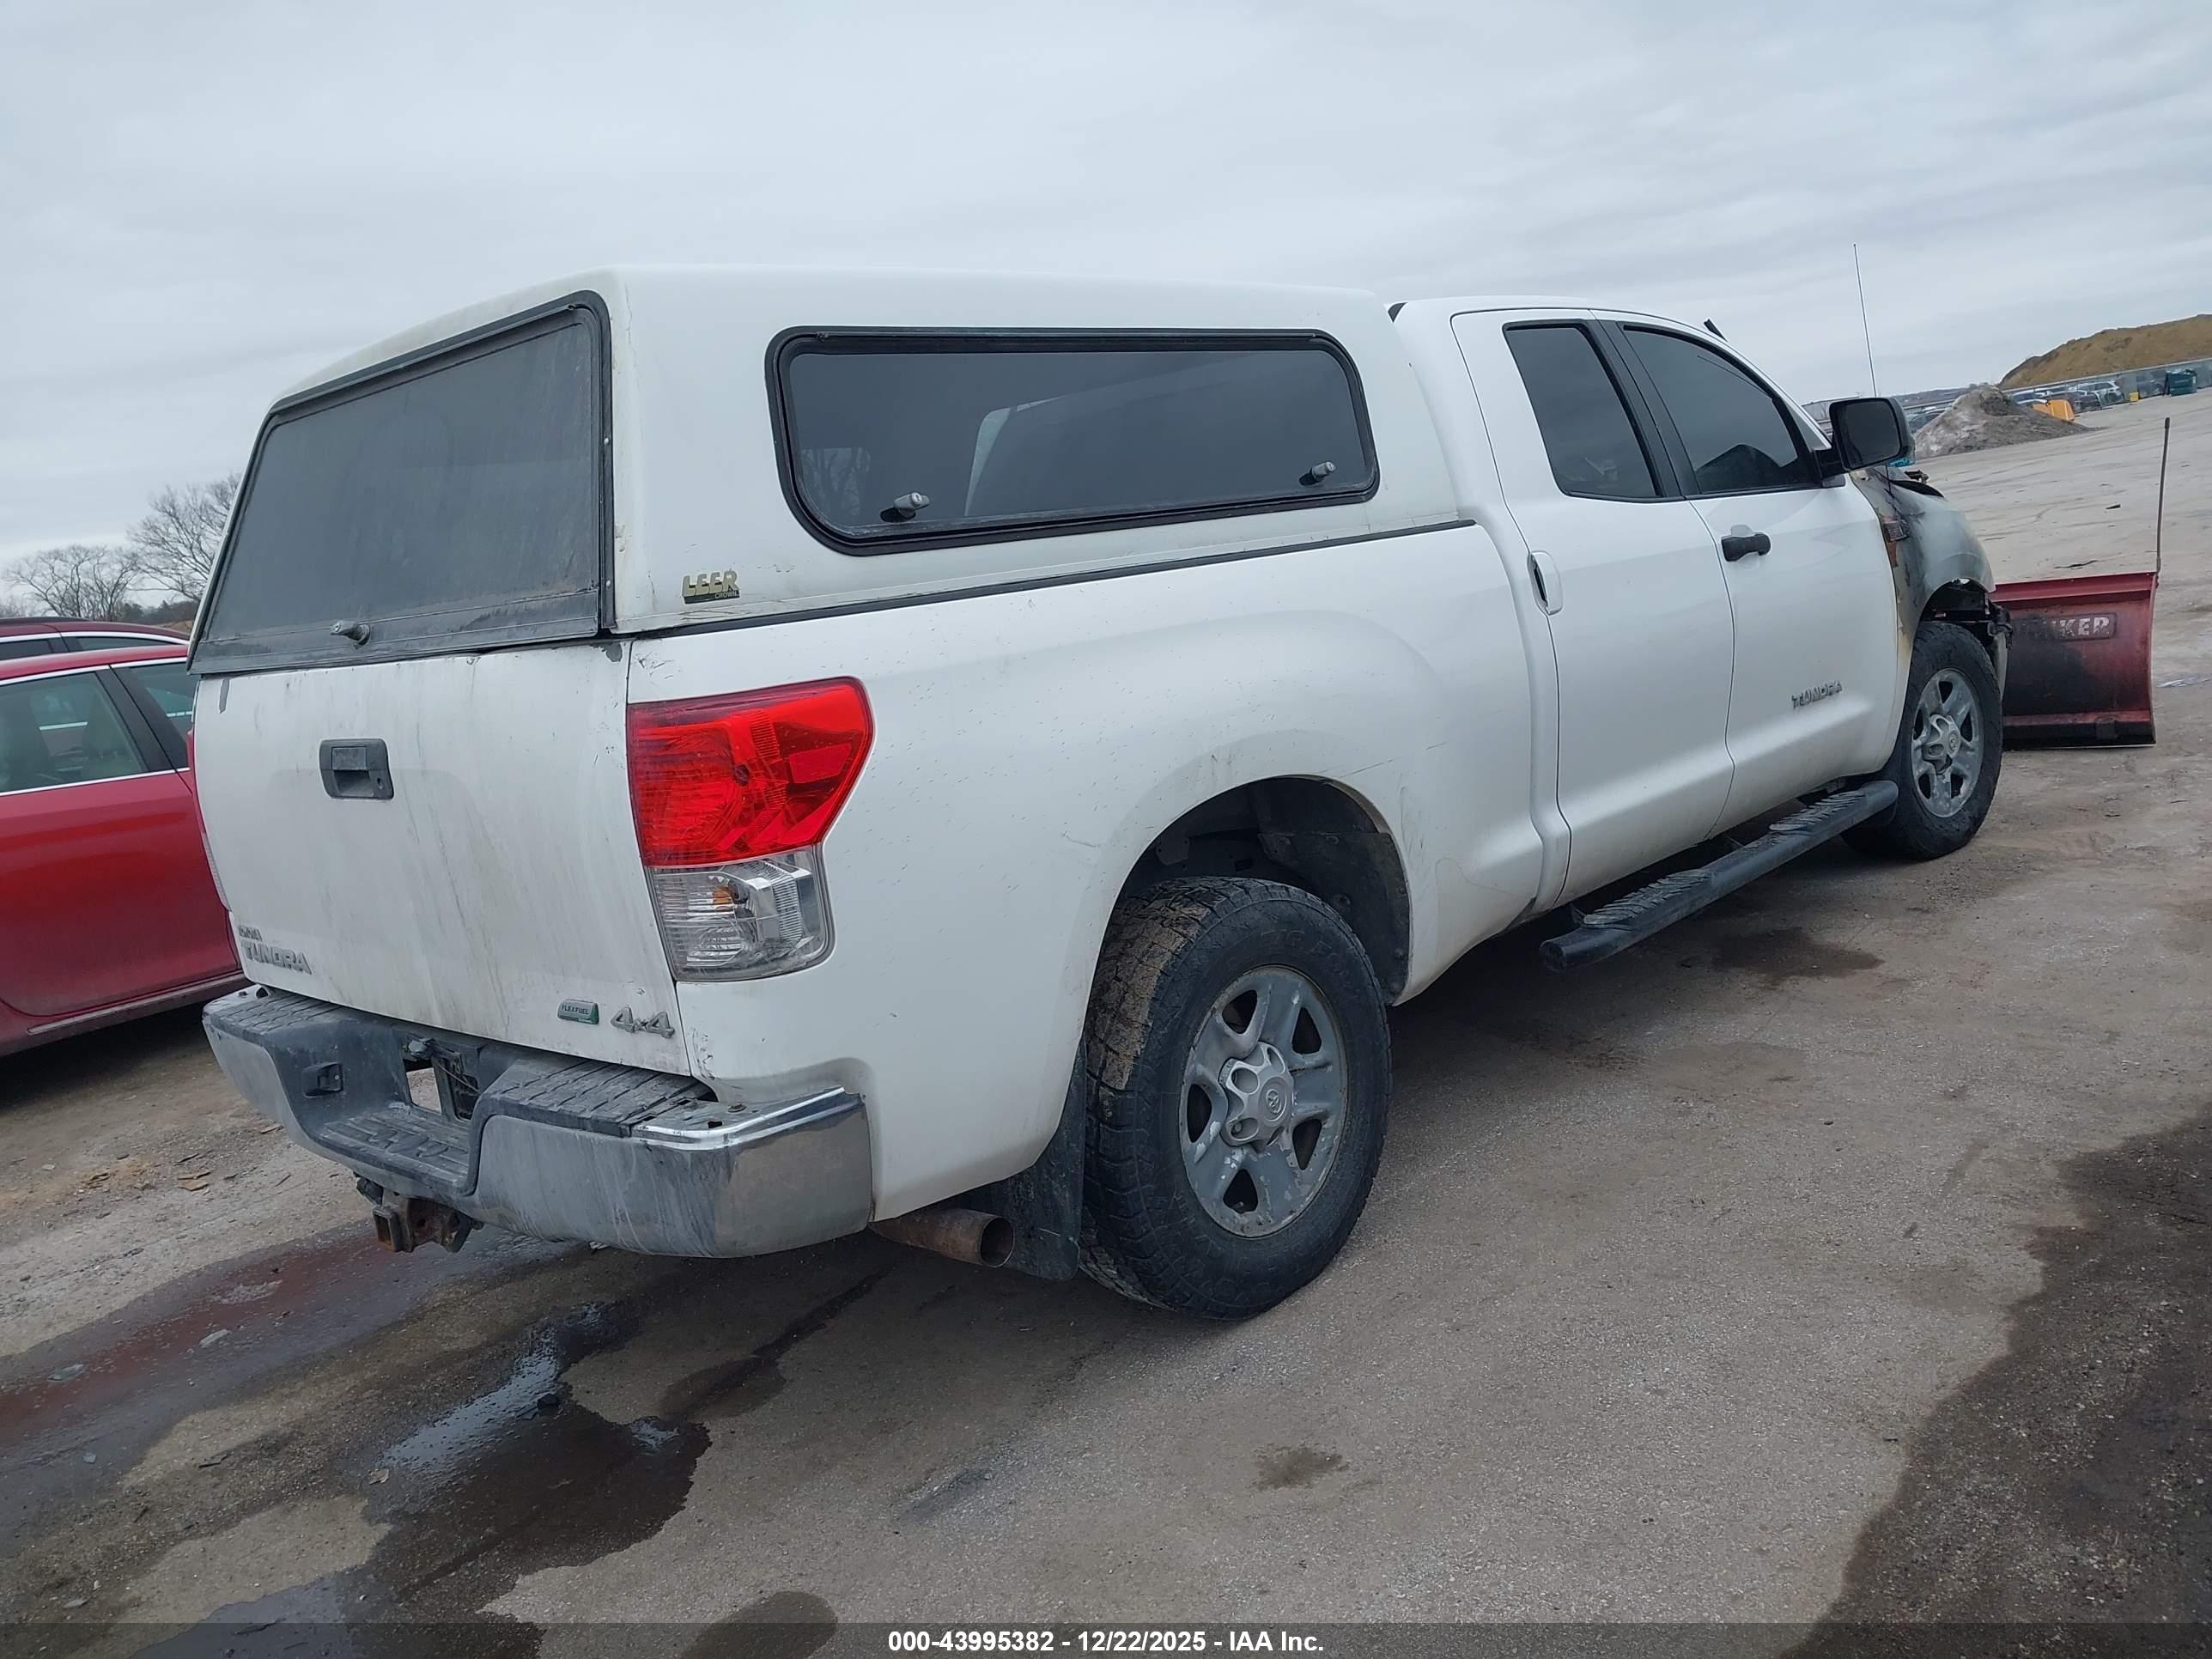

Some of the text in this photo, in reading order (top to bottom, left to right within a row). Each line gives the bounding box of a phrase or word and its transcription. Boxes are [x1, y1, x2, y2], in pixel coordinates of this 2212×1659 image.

[683, 570, 740, 597] LEER
[1791, 680, 1843, 708] TUNDRA
[240, 939, 313, 975] TUNDRA
